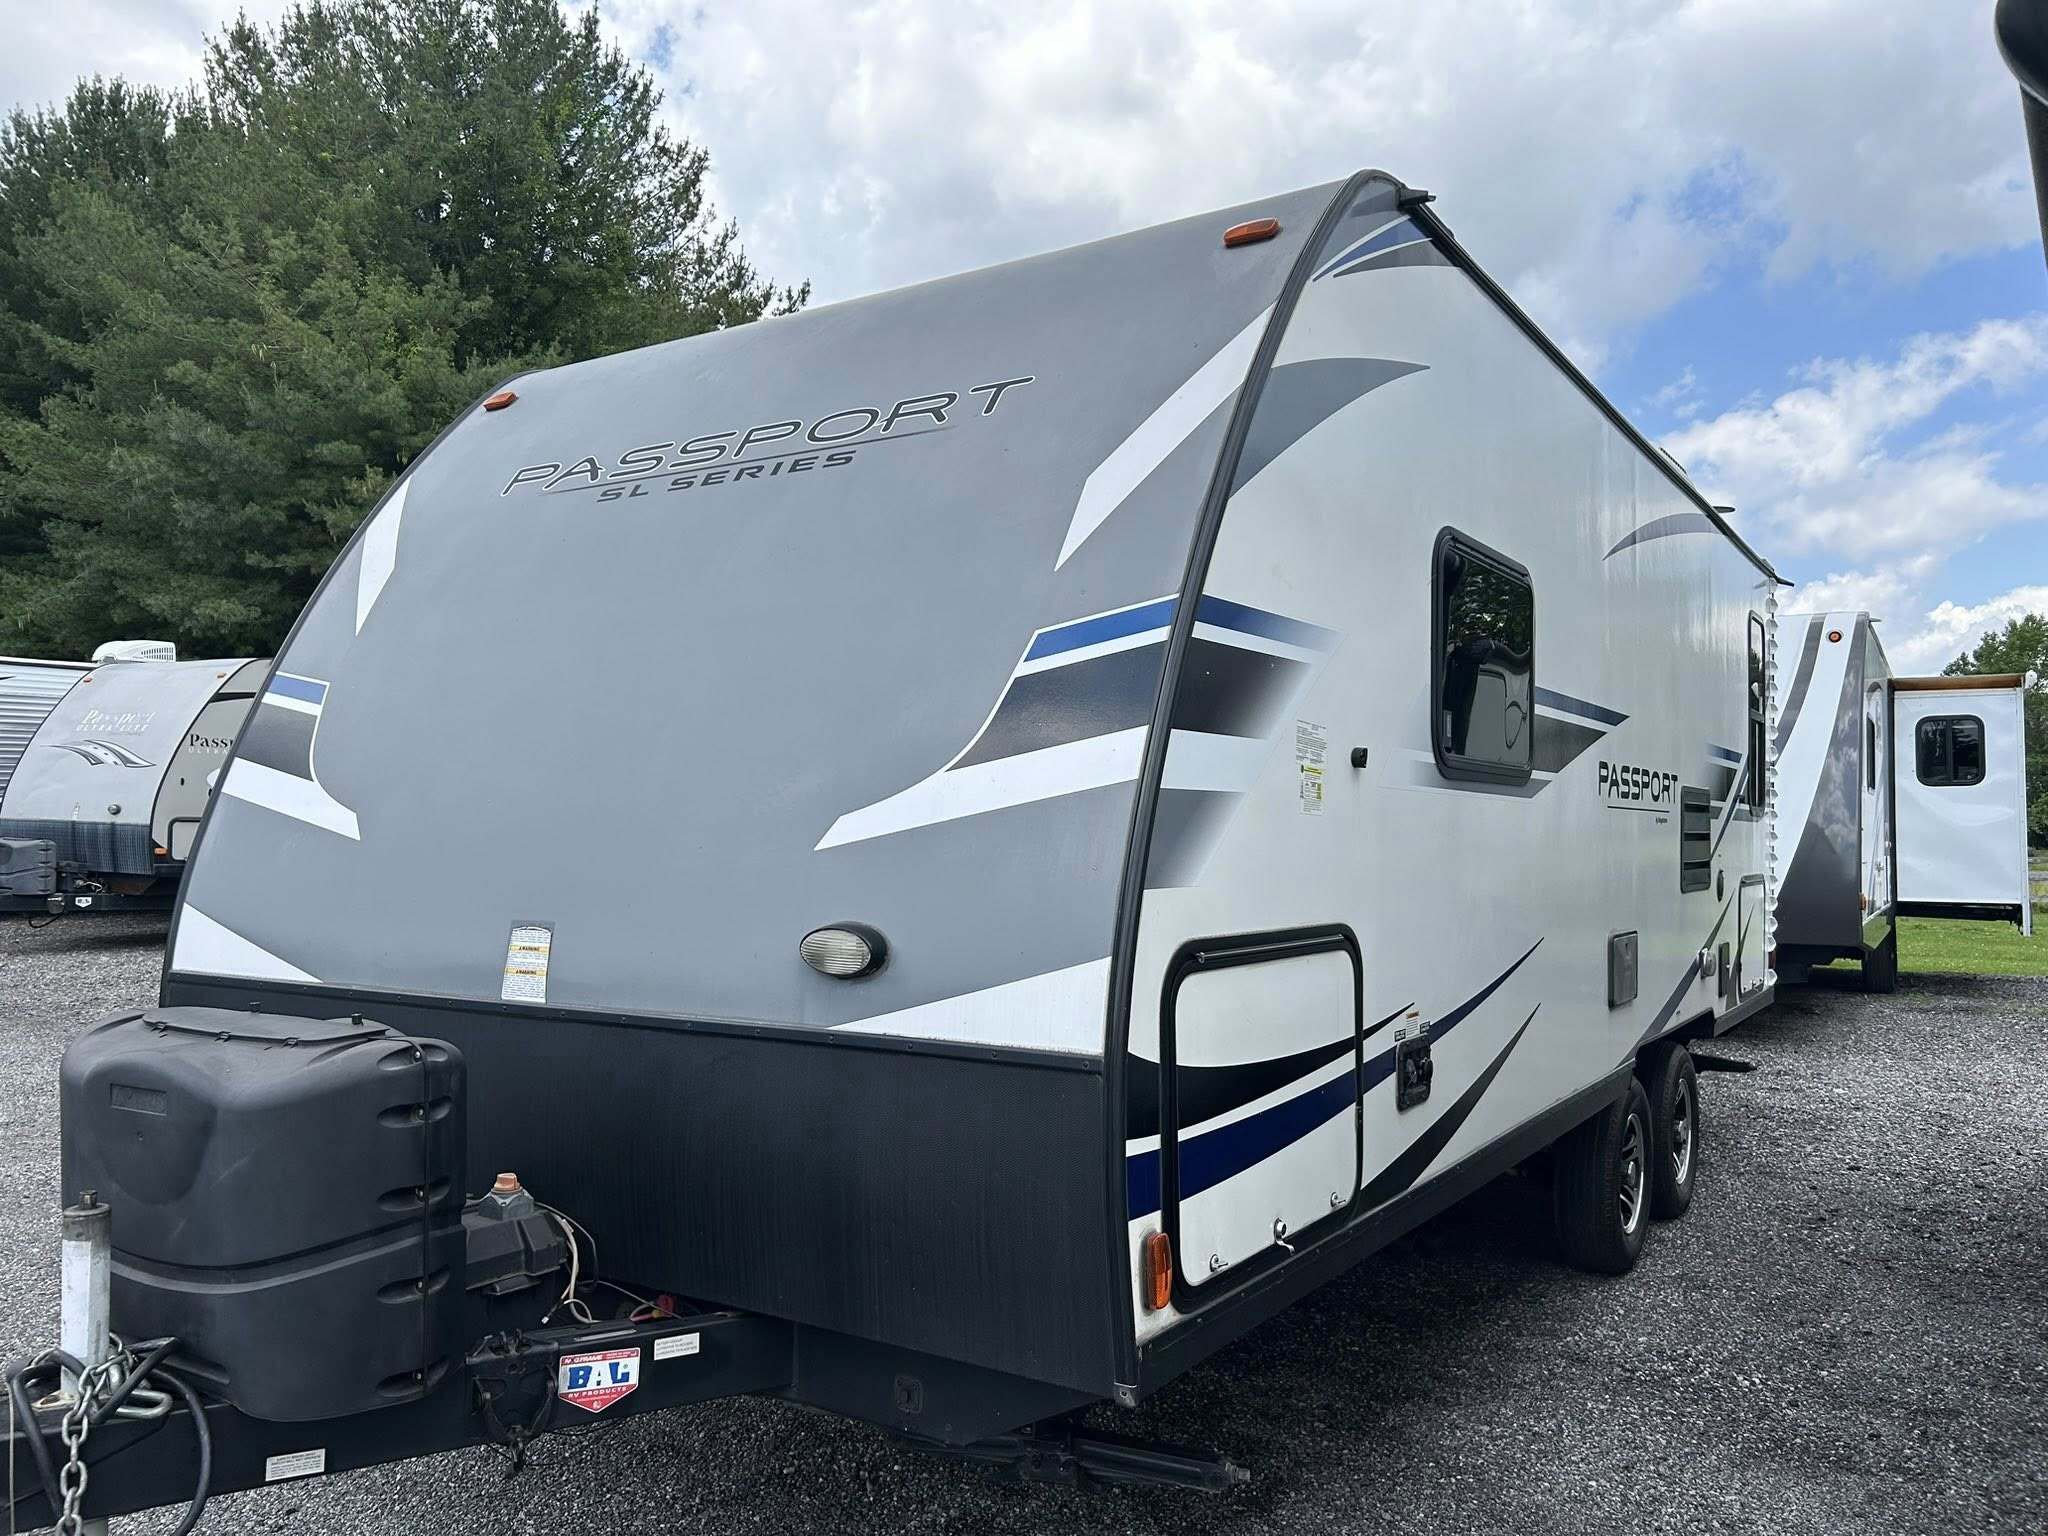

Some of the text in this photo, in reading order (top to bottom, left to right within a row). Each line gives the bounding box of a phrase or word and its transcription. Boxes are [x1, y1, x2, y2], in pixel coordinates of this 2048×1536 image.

[502, 376, 1035, 496] PASSPORT
[597, 450, 857, 502] SL SERIES
[1598, 760, 1678, 804] PASSPORT
[567, 1361, 630, 1389] BAL
